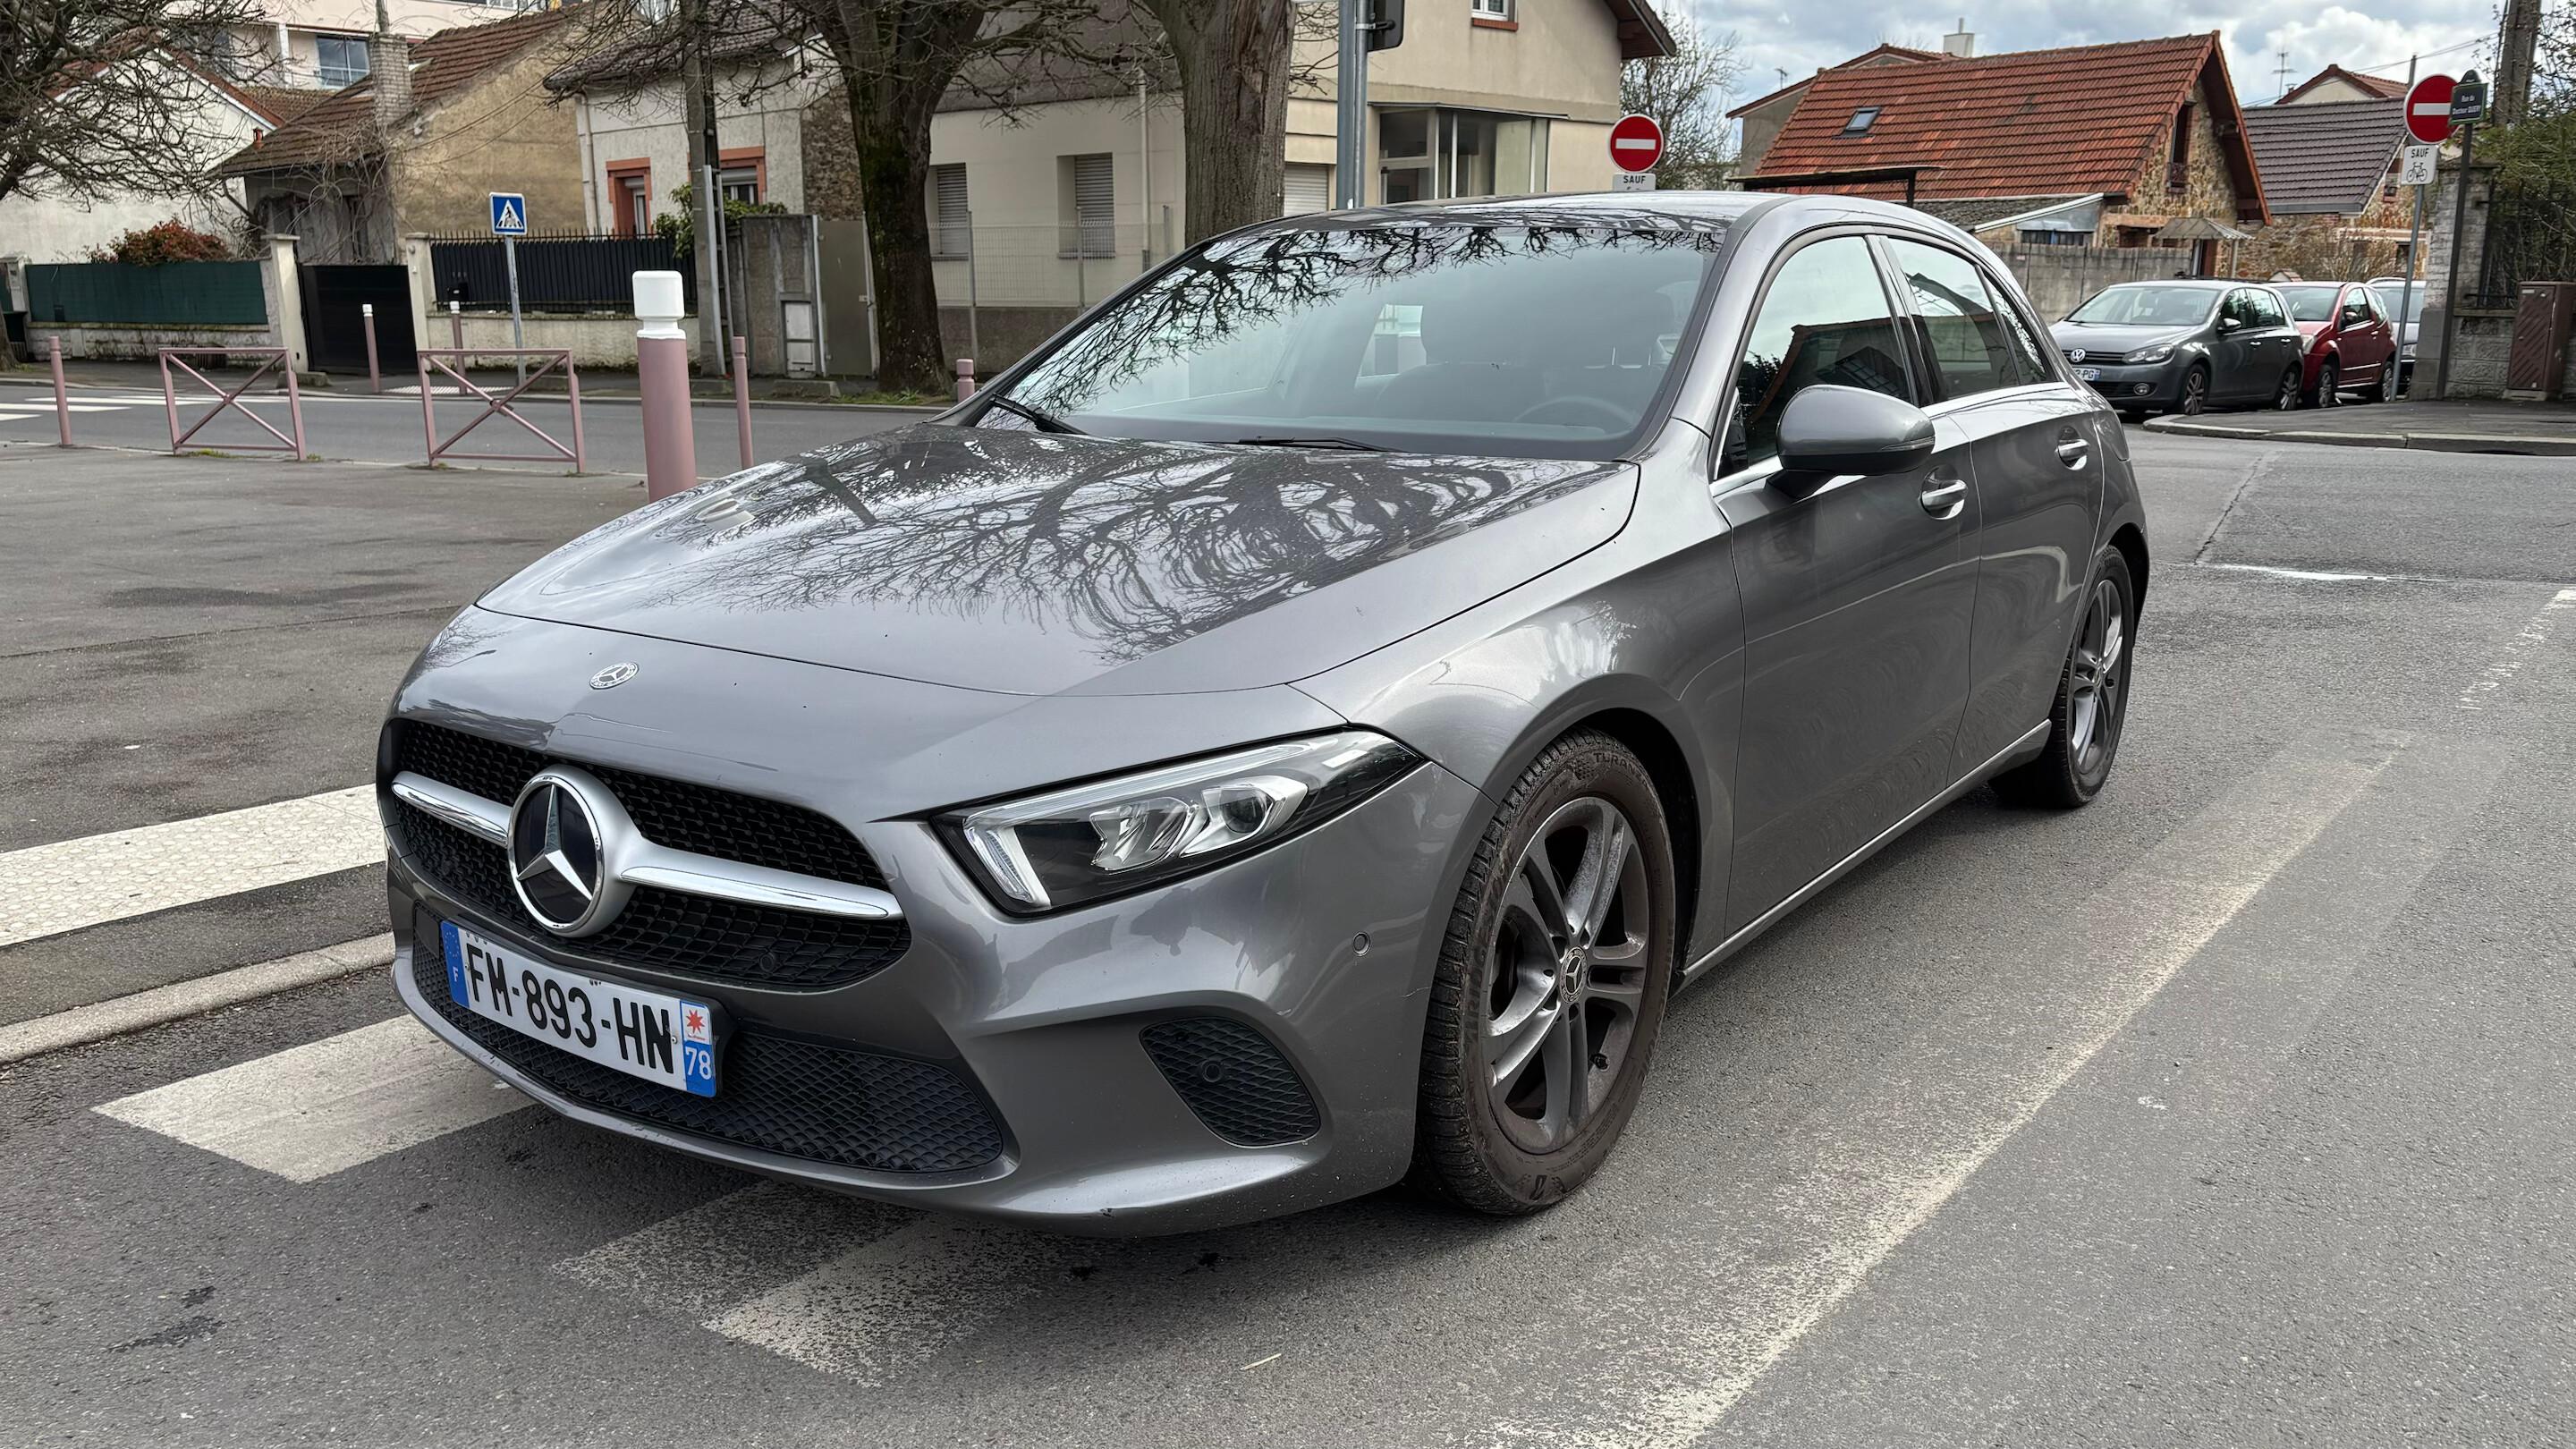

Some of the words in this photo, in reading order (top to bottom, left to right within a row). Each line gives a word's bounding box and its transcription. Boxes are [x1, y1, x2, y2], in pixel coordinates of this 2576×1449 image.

[2411, 148, 2429, 157] SAUF
[1623, 175, 1646, 184] SAUF
[452, 966, 459, 982] F
[466, 943, 674, 1074] FM-893-HN
[685, 1046, 712, 1080] 78
